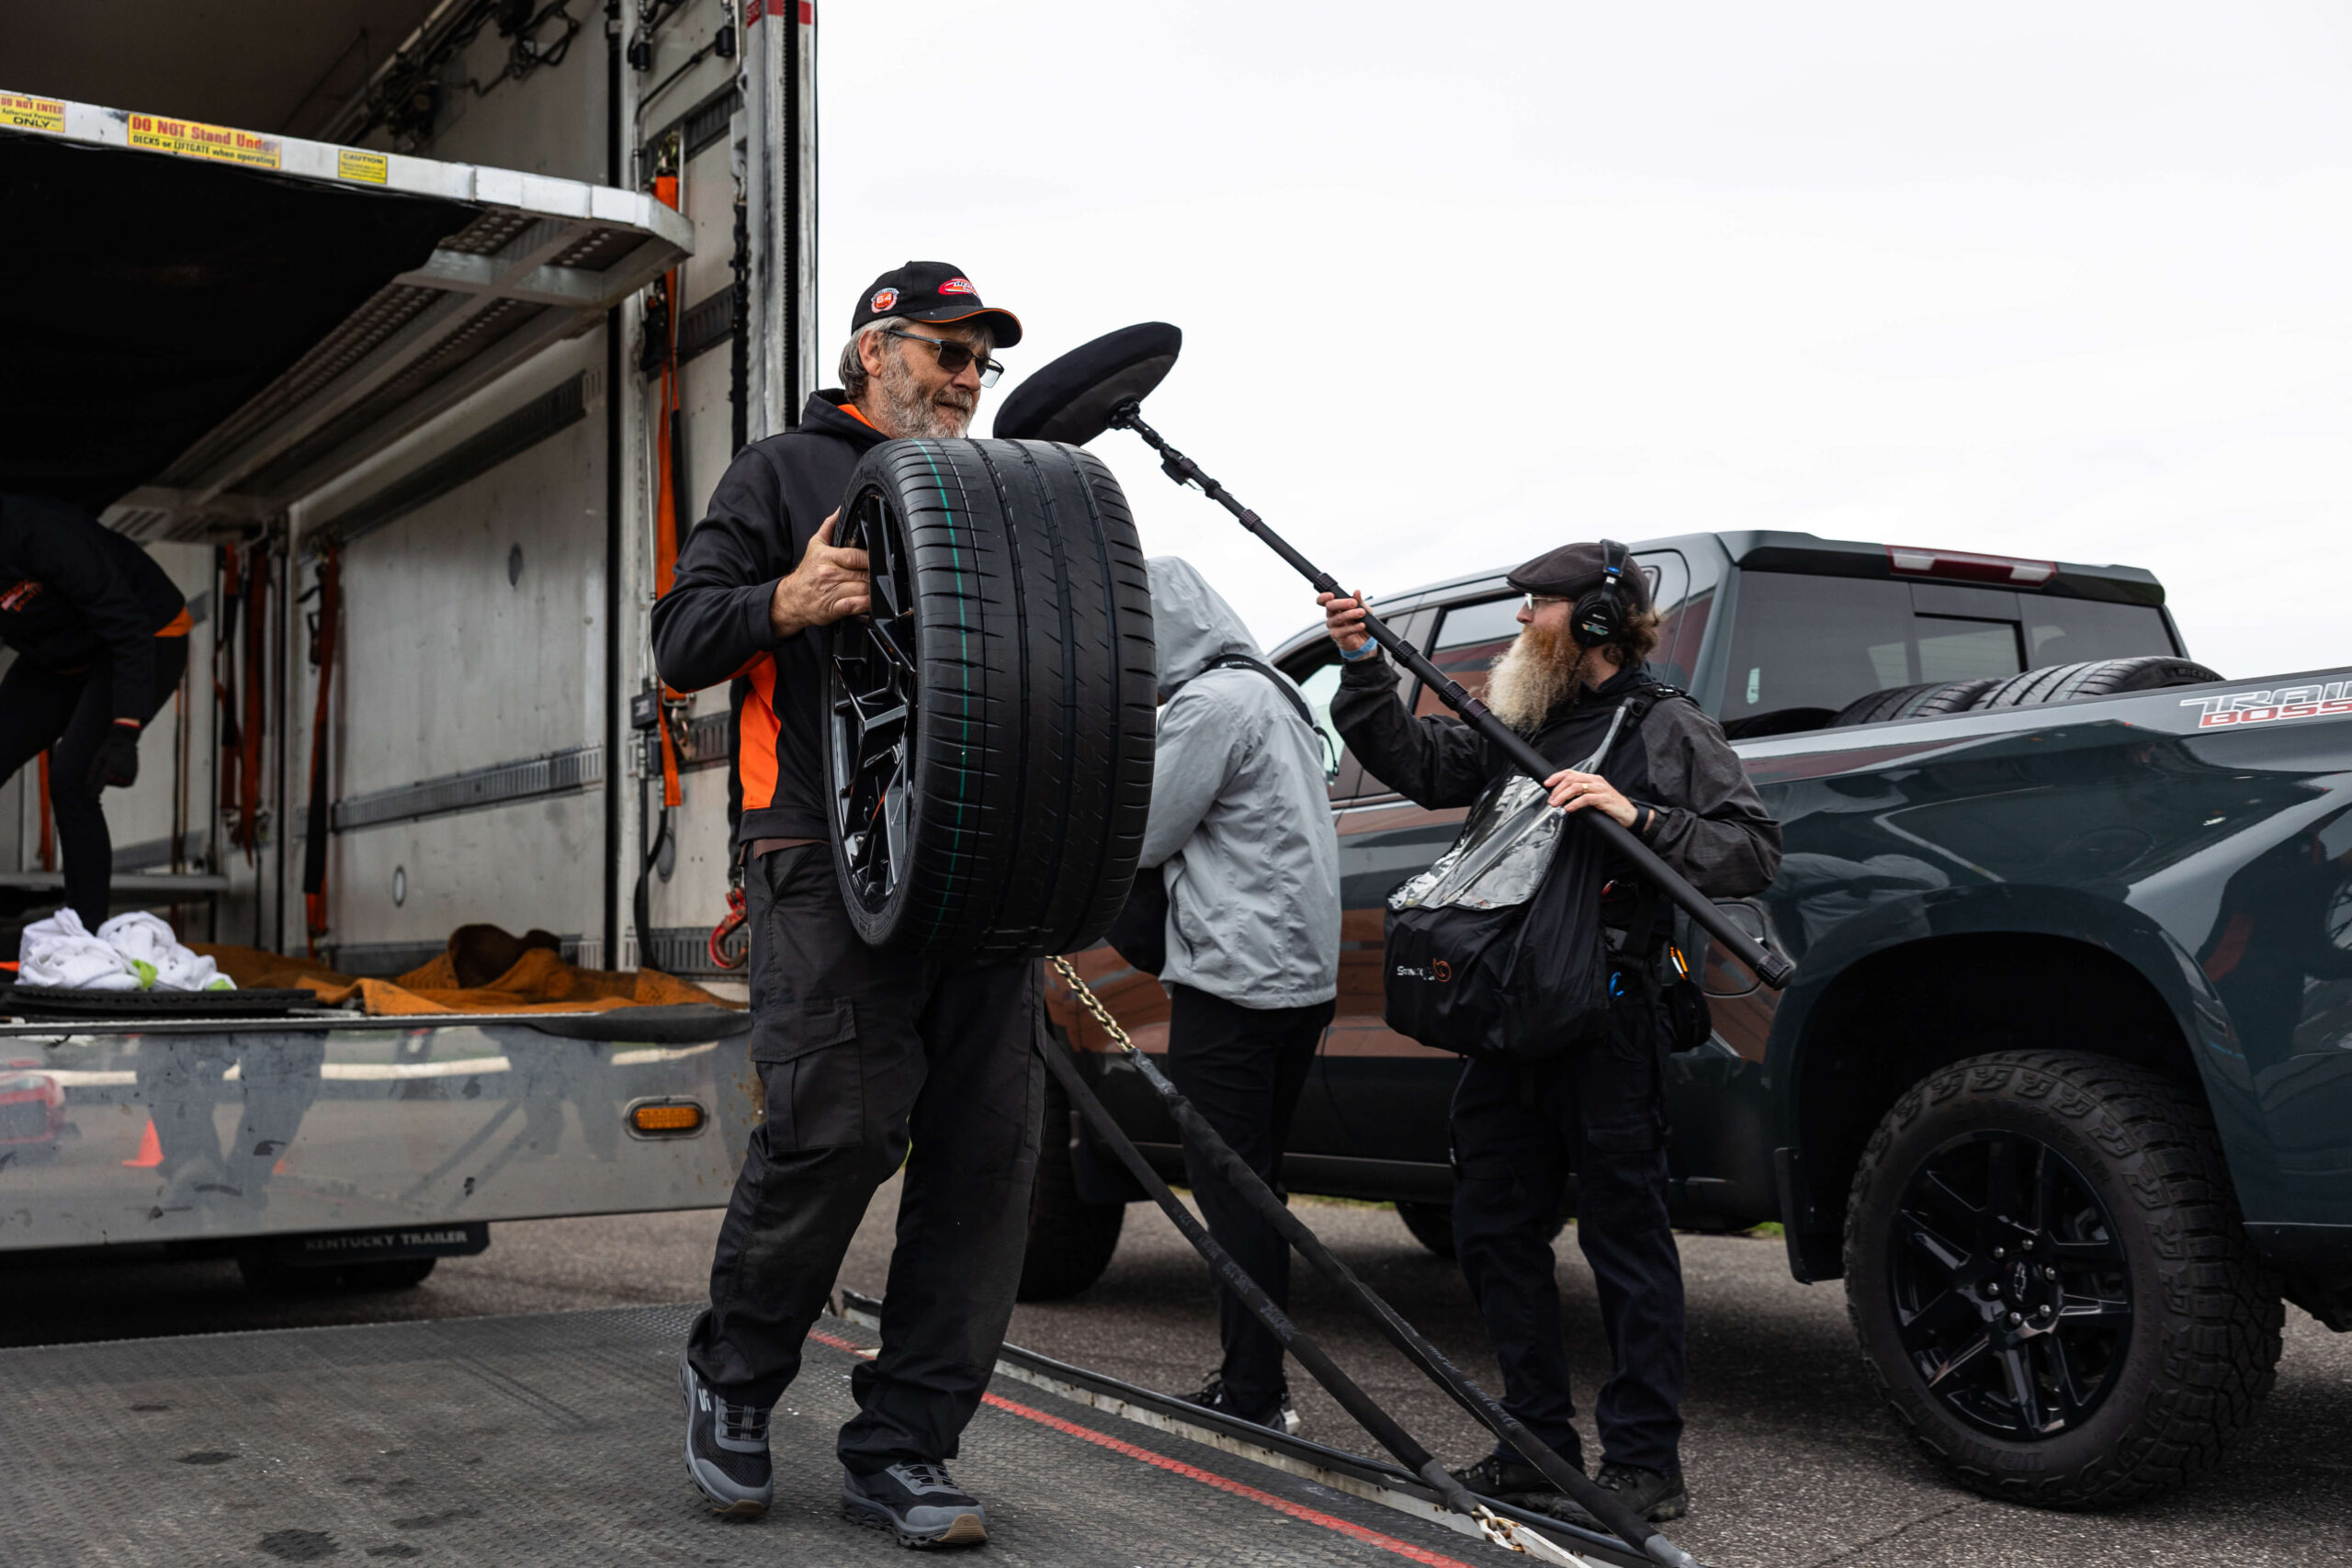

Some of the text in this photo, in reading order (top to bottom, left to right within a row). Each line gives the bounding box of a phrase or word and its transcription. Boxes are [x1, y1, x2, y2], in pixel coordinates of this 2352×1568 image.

[1, 97, 63, 114] DO NOT ENTER
[14, 117, 50, 128] ONLY
[132, 117, 152, 131] DO
[157, 120, 186, 137] NOT
[191, 127, 231, 144] Stand
[133, 135, 160, 146] DECKS
[175, 141, 209, 154] LIFTGATE
[212, 149, 234, 158] when
[237, 152, 276, 166] operating
[343, 153, 383, 164] CAUTION
[876, 294, 891, 303] 64
[2199, 698, 2352, 728] BOSS
[306, 1231, 468, 1250] KENTUCKY TRAILER
